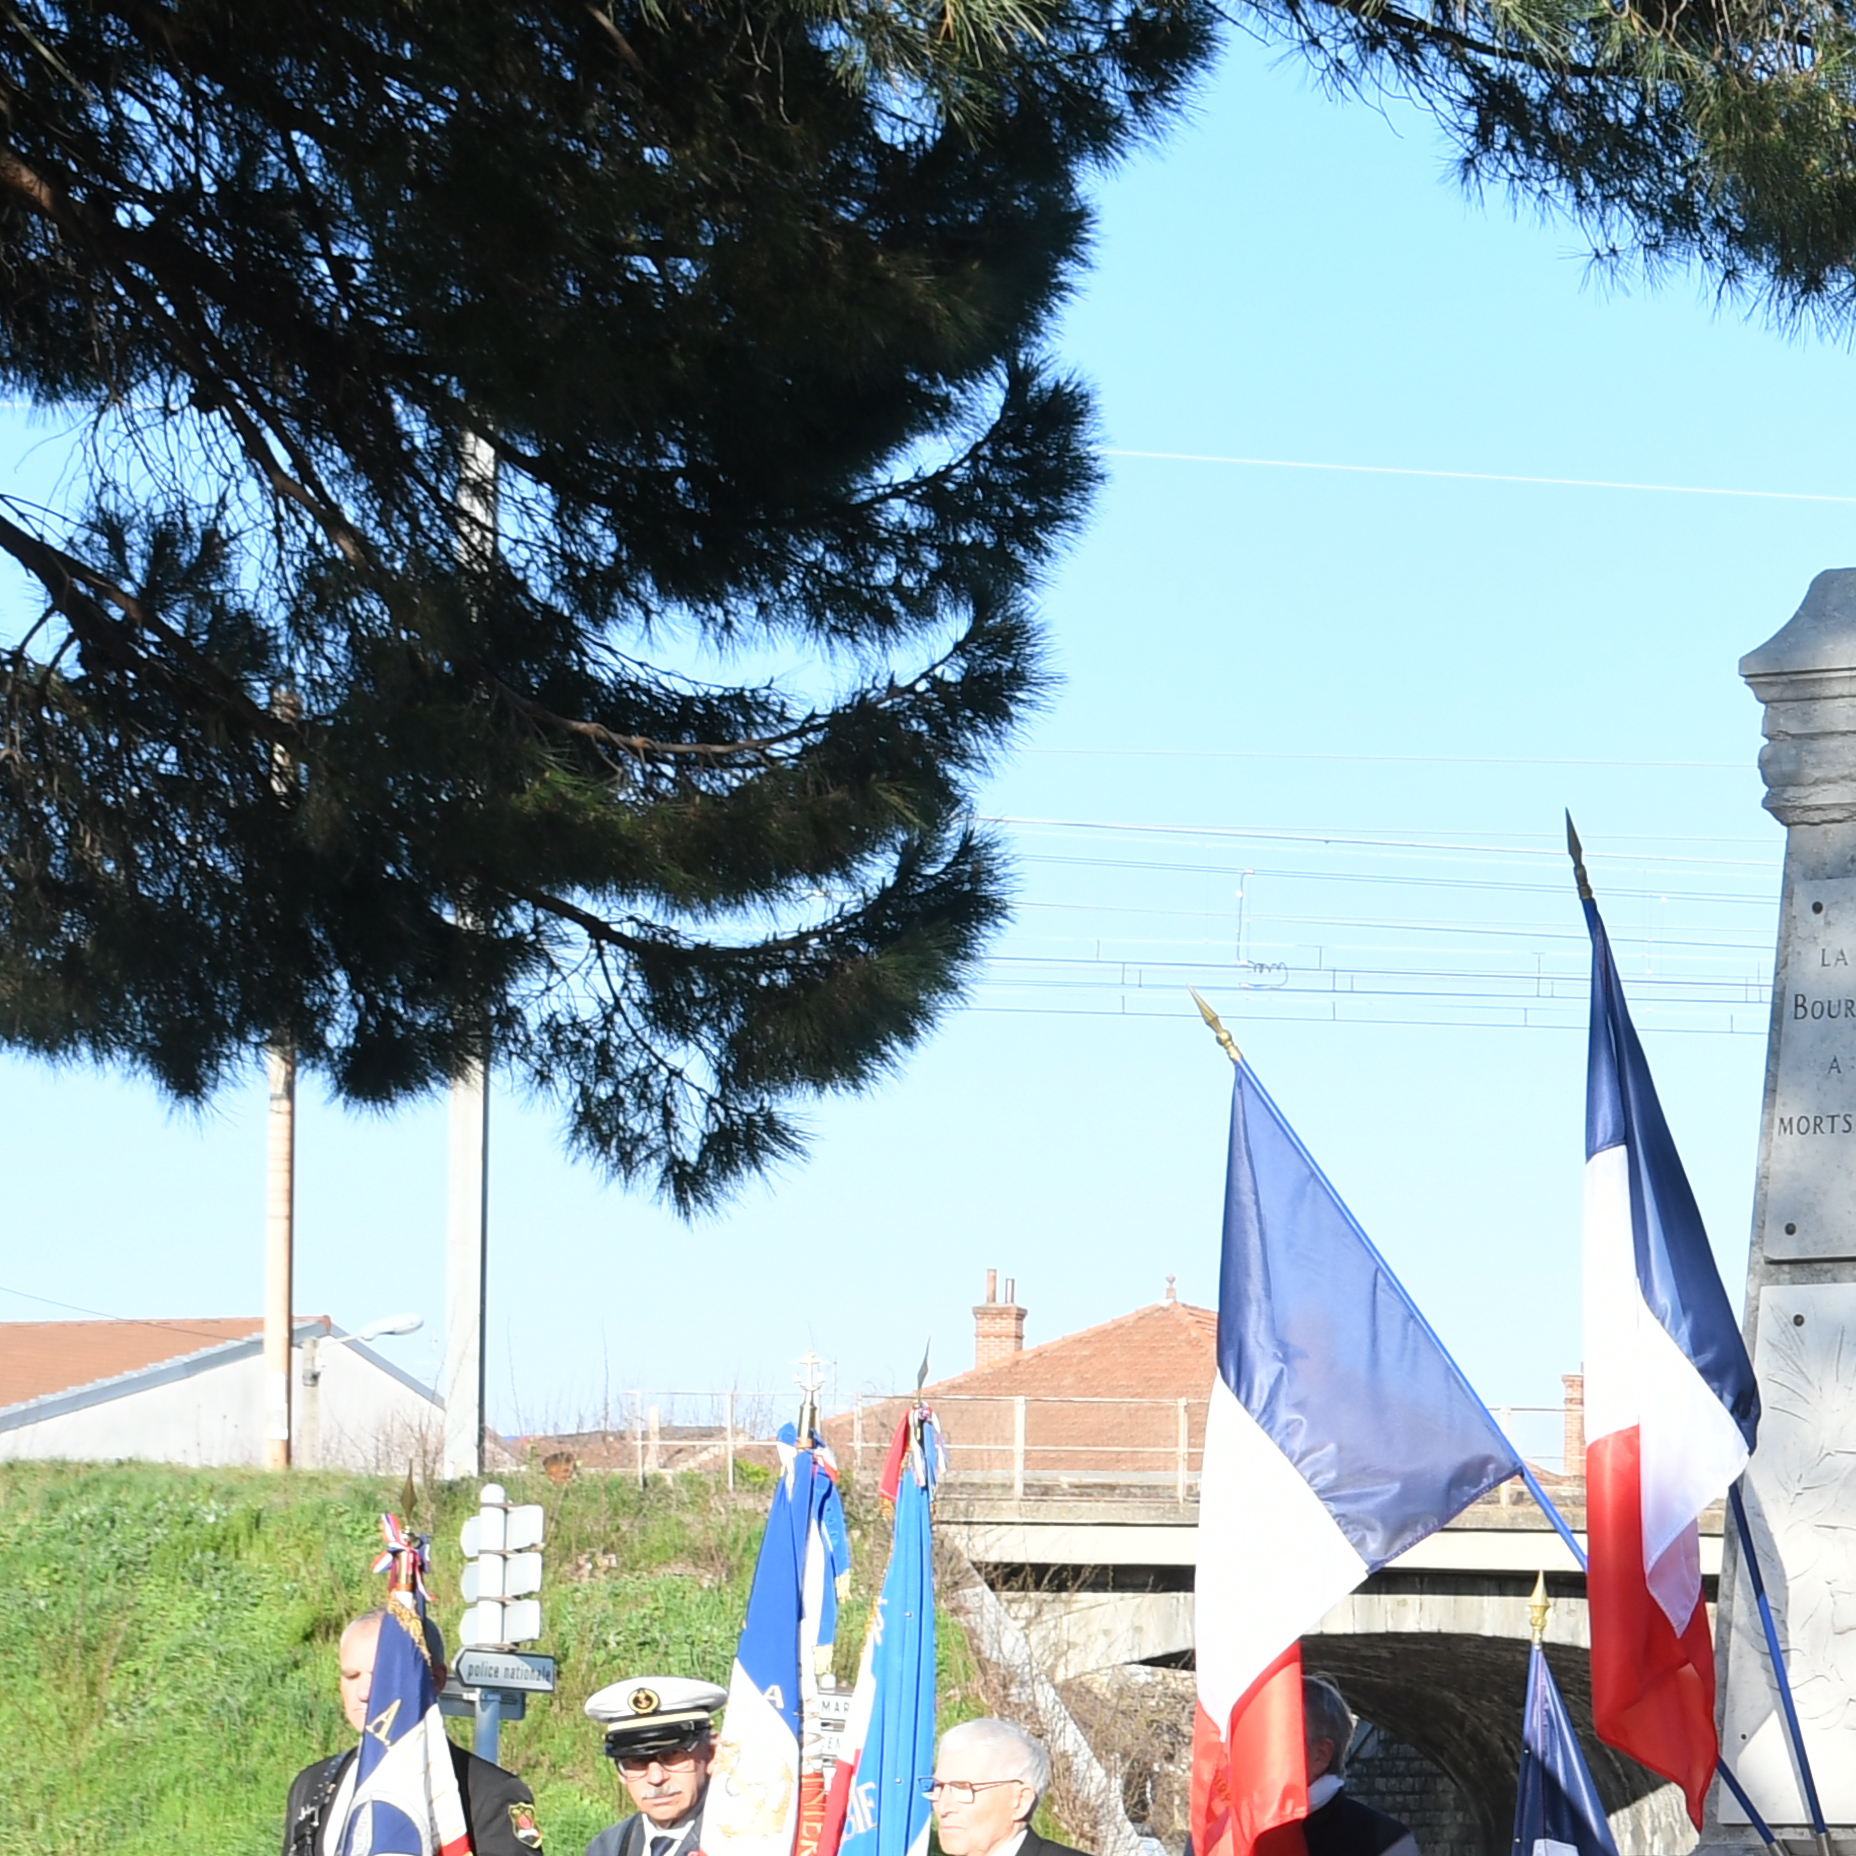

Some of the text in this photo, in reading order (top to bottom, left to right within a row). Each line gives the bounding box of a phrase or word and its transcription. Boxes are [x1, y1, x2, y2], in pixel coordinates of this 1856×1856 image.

[1821, 948, 1849, 967] LA
[1828, 1056, 1842, 1074] A
[1778, 1114, 1852, 1136] MORTS
[468, 1661, 551, 1681] police nationale
